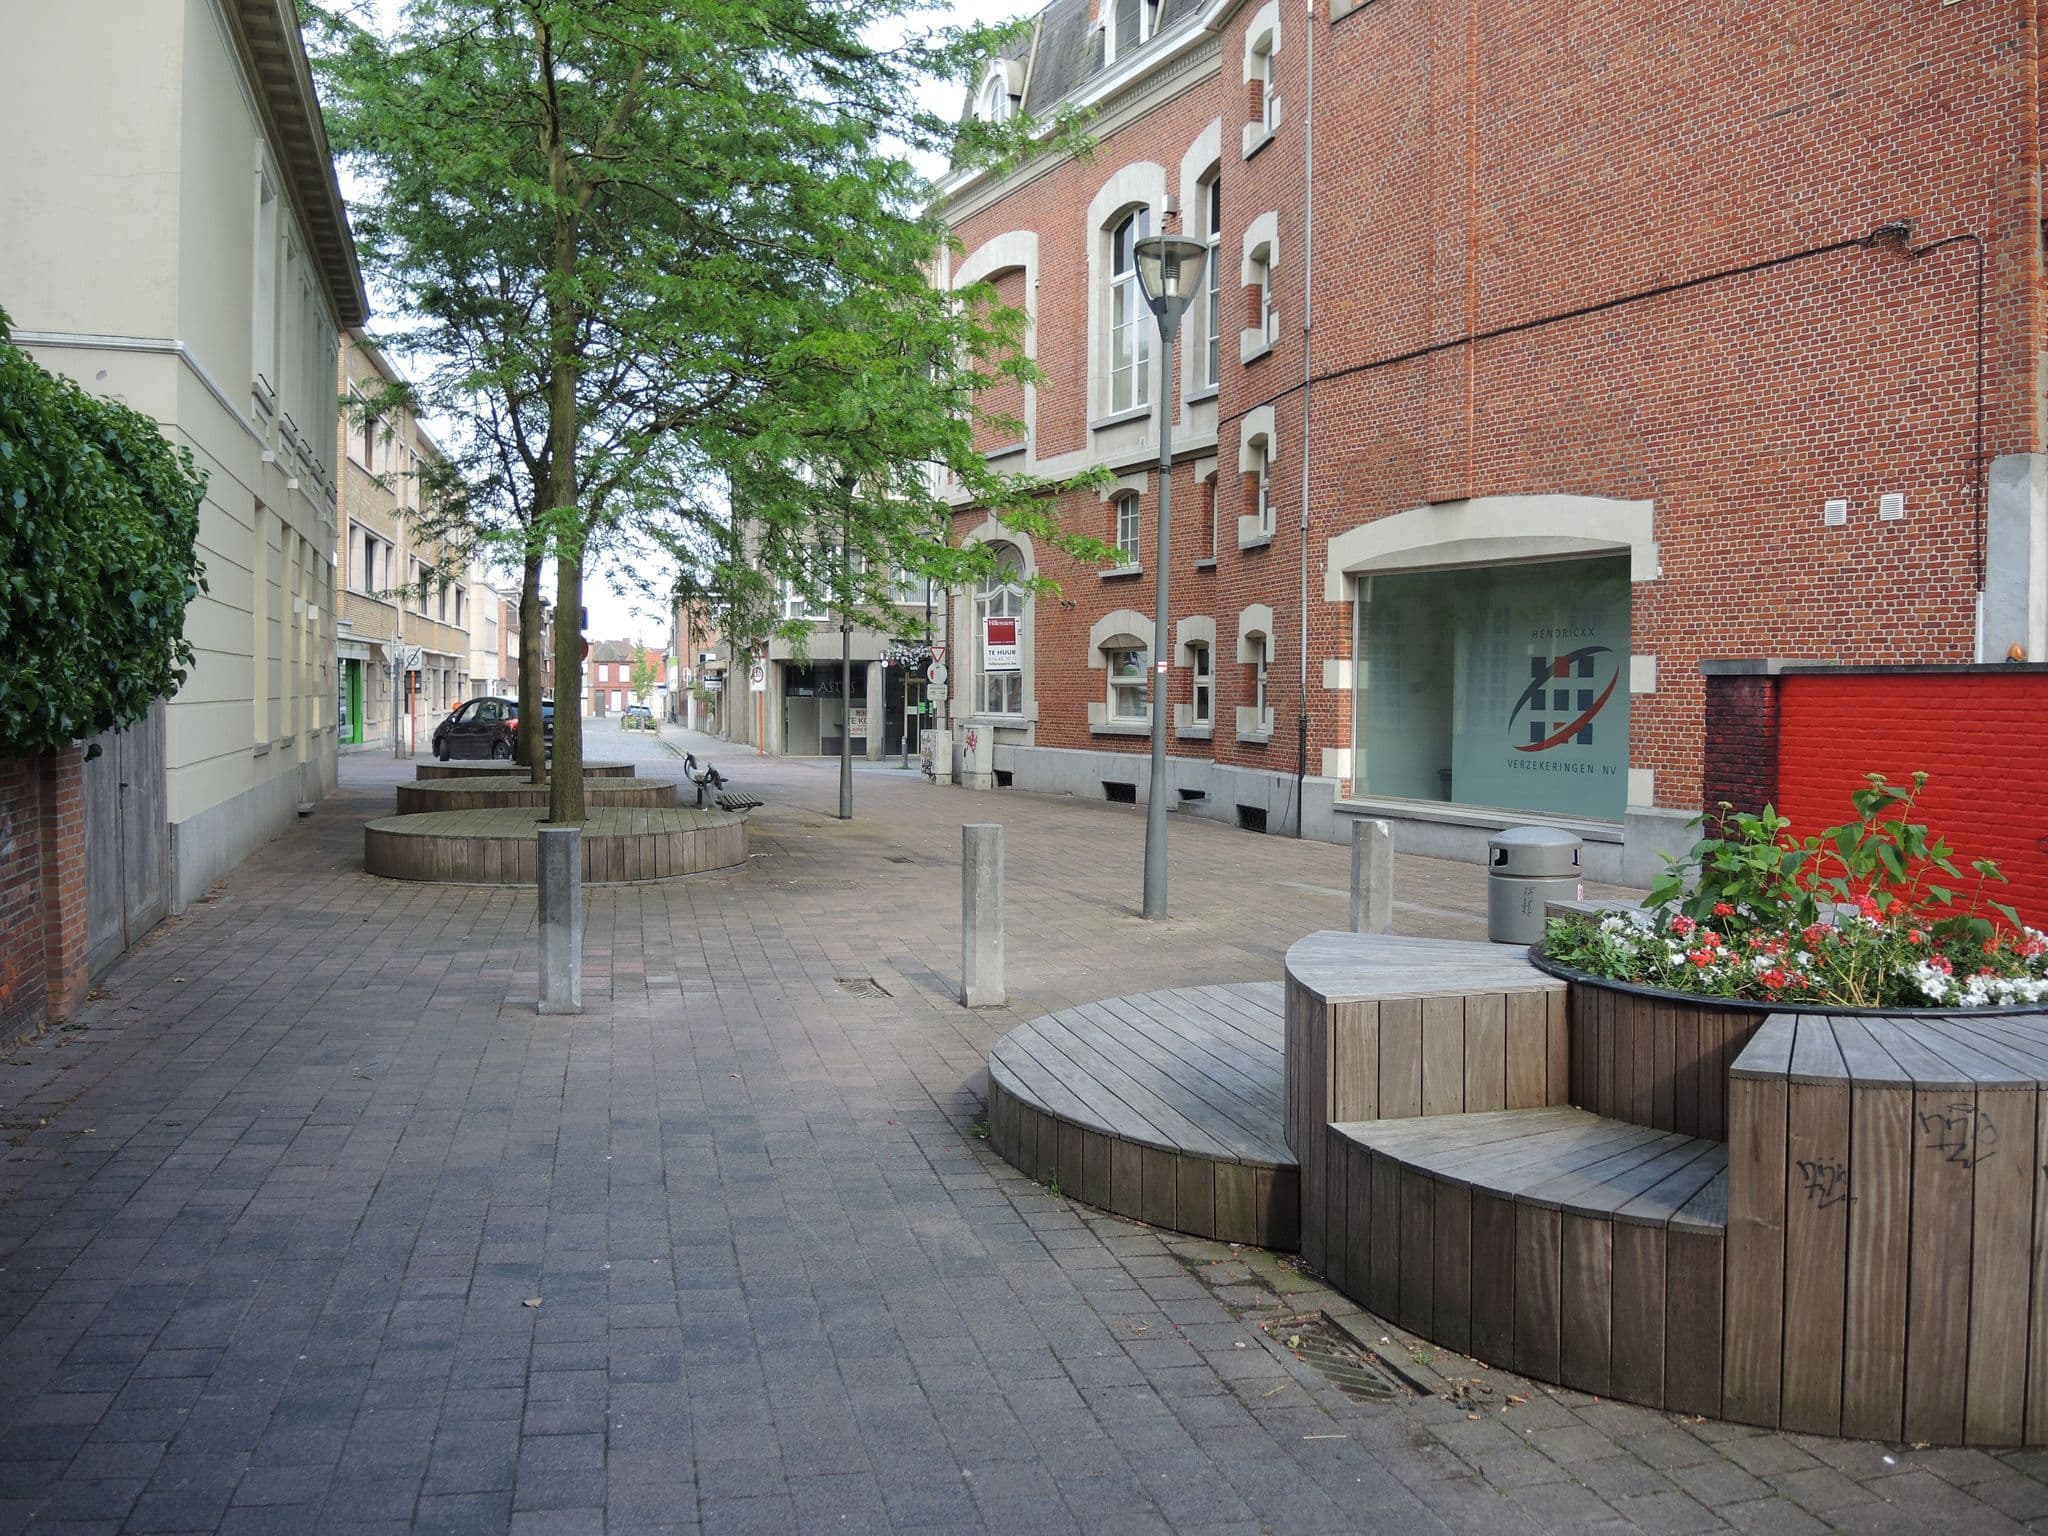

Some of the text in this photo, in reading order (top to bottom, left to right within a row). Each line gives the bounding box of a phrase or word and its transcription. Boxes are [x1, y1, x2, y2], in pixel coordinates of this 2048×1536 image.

[1531, 627, 1595, 640] HENDRICKX
[1507, 759, 1617, 776] VERZEKERINGEN NV
